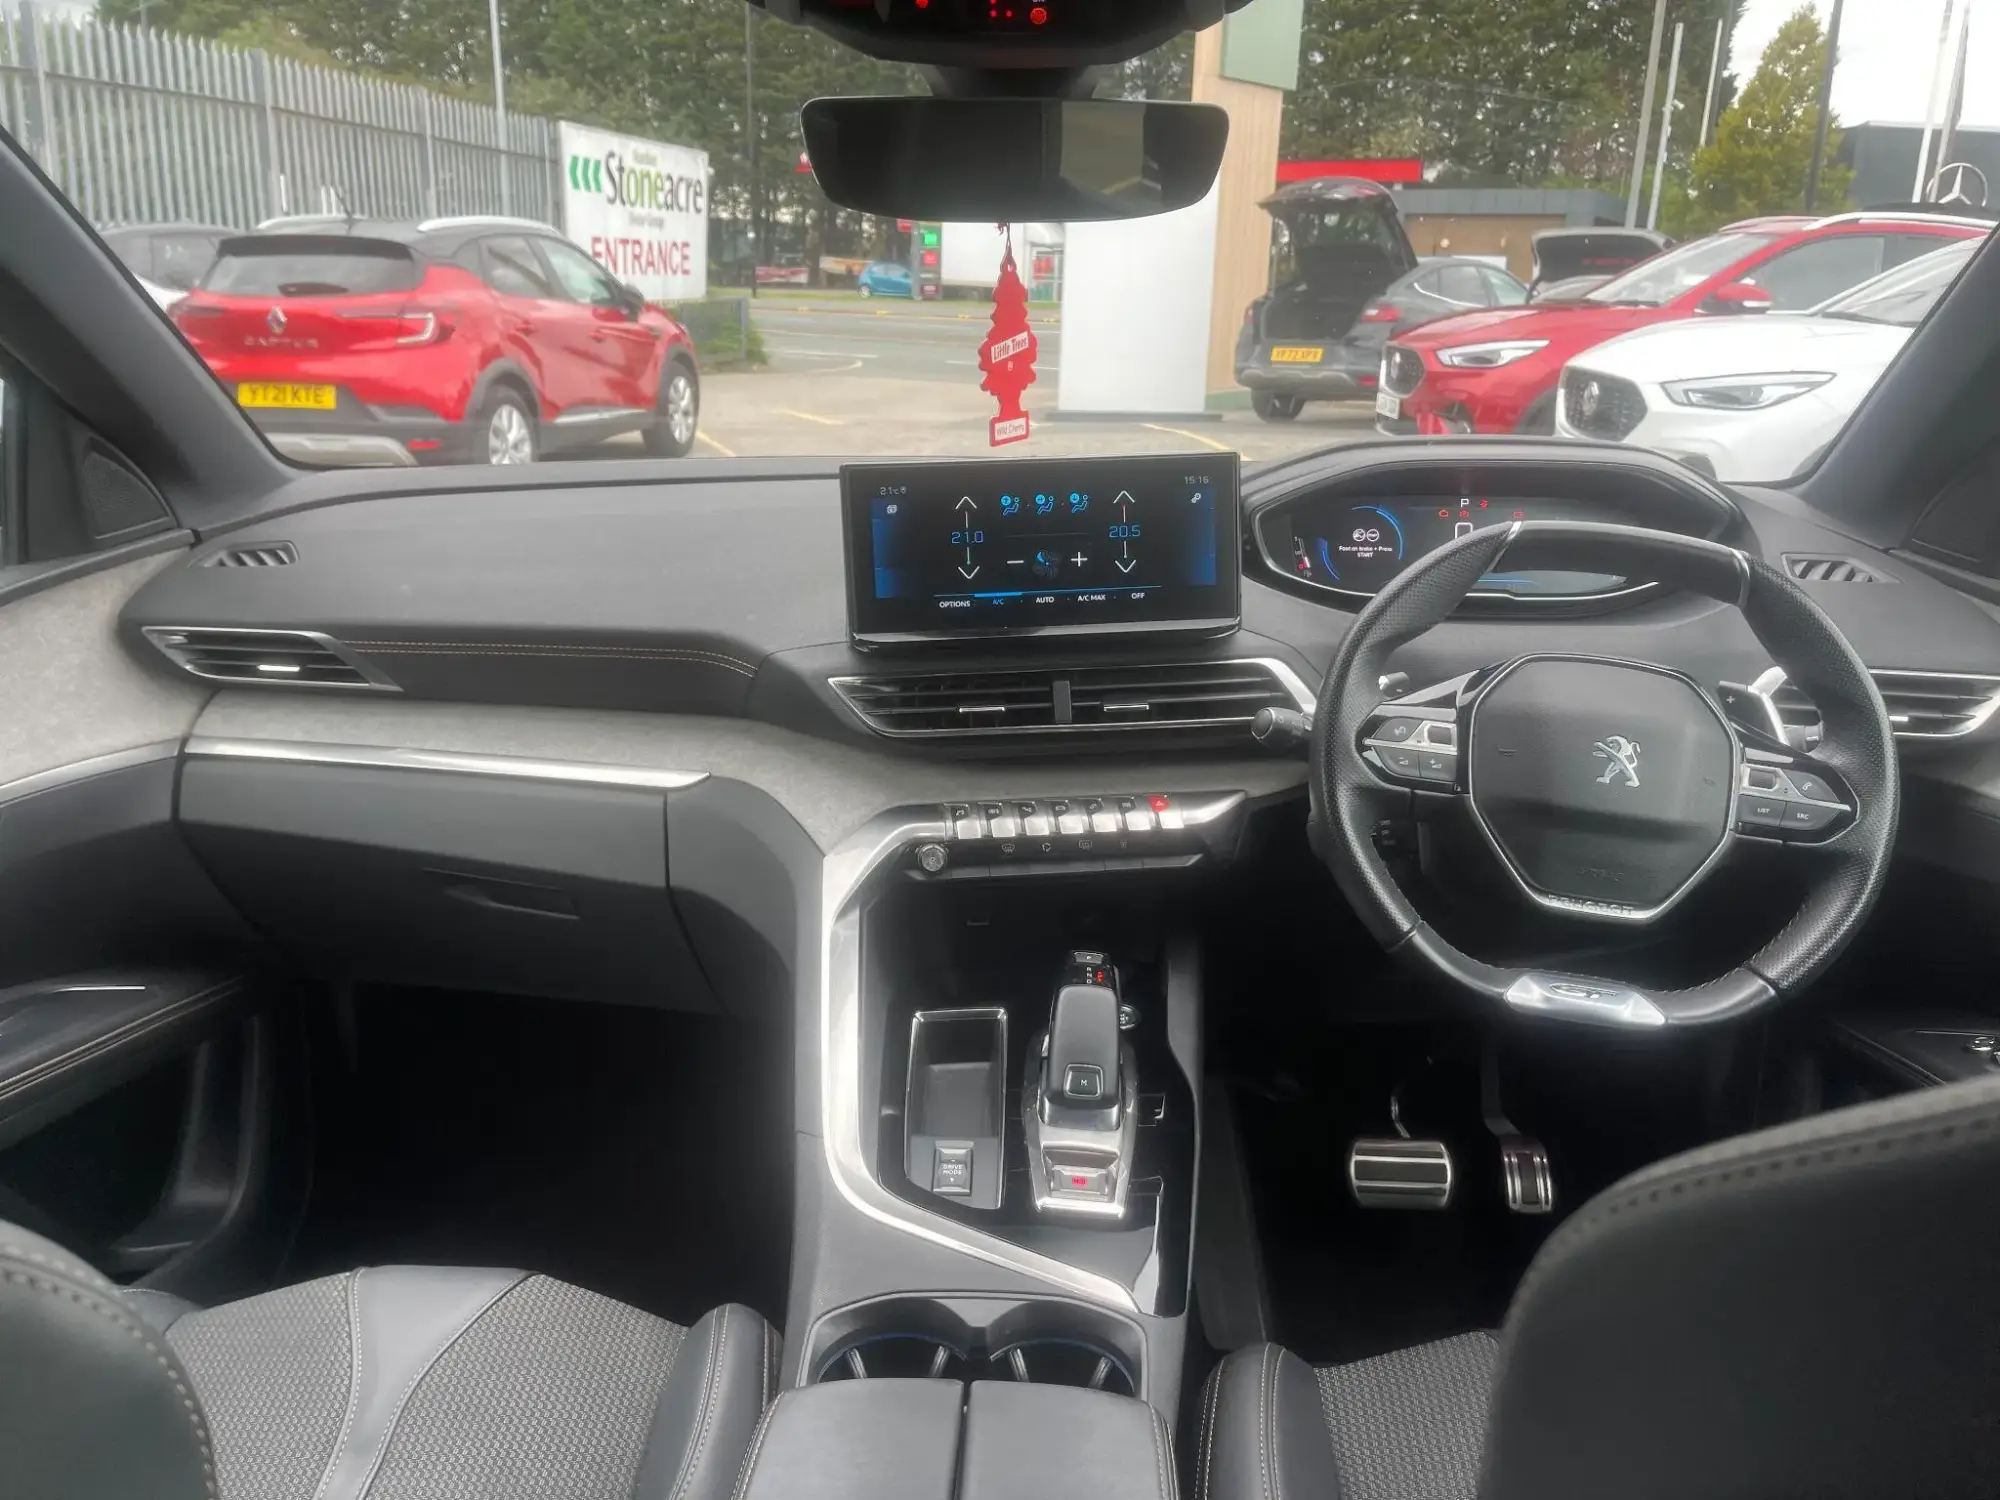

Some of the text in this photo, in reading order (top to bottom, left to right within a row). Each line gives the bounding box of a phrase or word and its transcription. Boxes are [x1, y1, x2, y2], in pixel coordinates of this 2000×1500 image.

[605, 150, 703, 214] Stoneacre
[591, 236, 691, 276] ENTRANCE
[993, 338, 1027, 362] Little Trees
[1184, 476, 1209, 485] 15:16
[1460, 498, 1470, 508] P
[1109, 525, 1141, 538] 20.5
[951, 531, 984, 544] 21.0
[1035, 596, 1055, 604] AUTO
[1131, 592, 1145, 600] OFF
[938, 600, 971, 609] OPTIONS
[992, 597, 1005, 606] A/C
[1796, 812, 1809, 820] SRC
[1080, 1079, 1088, 1087] M
